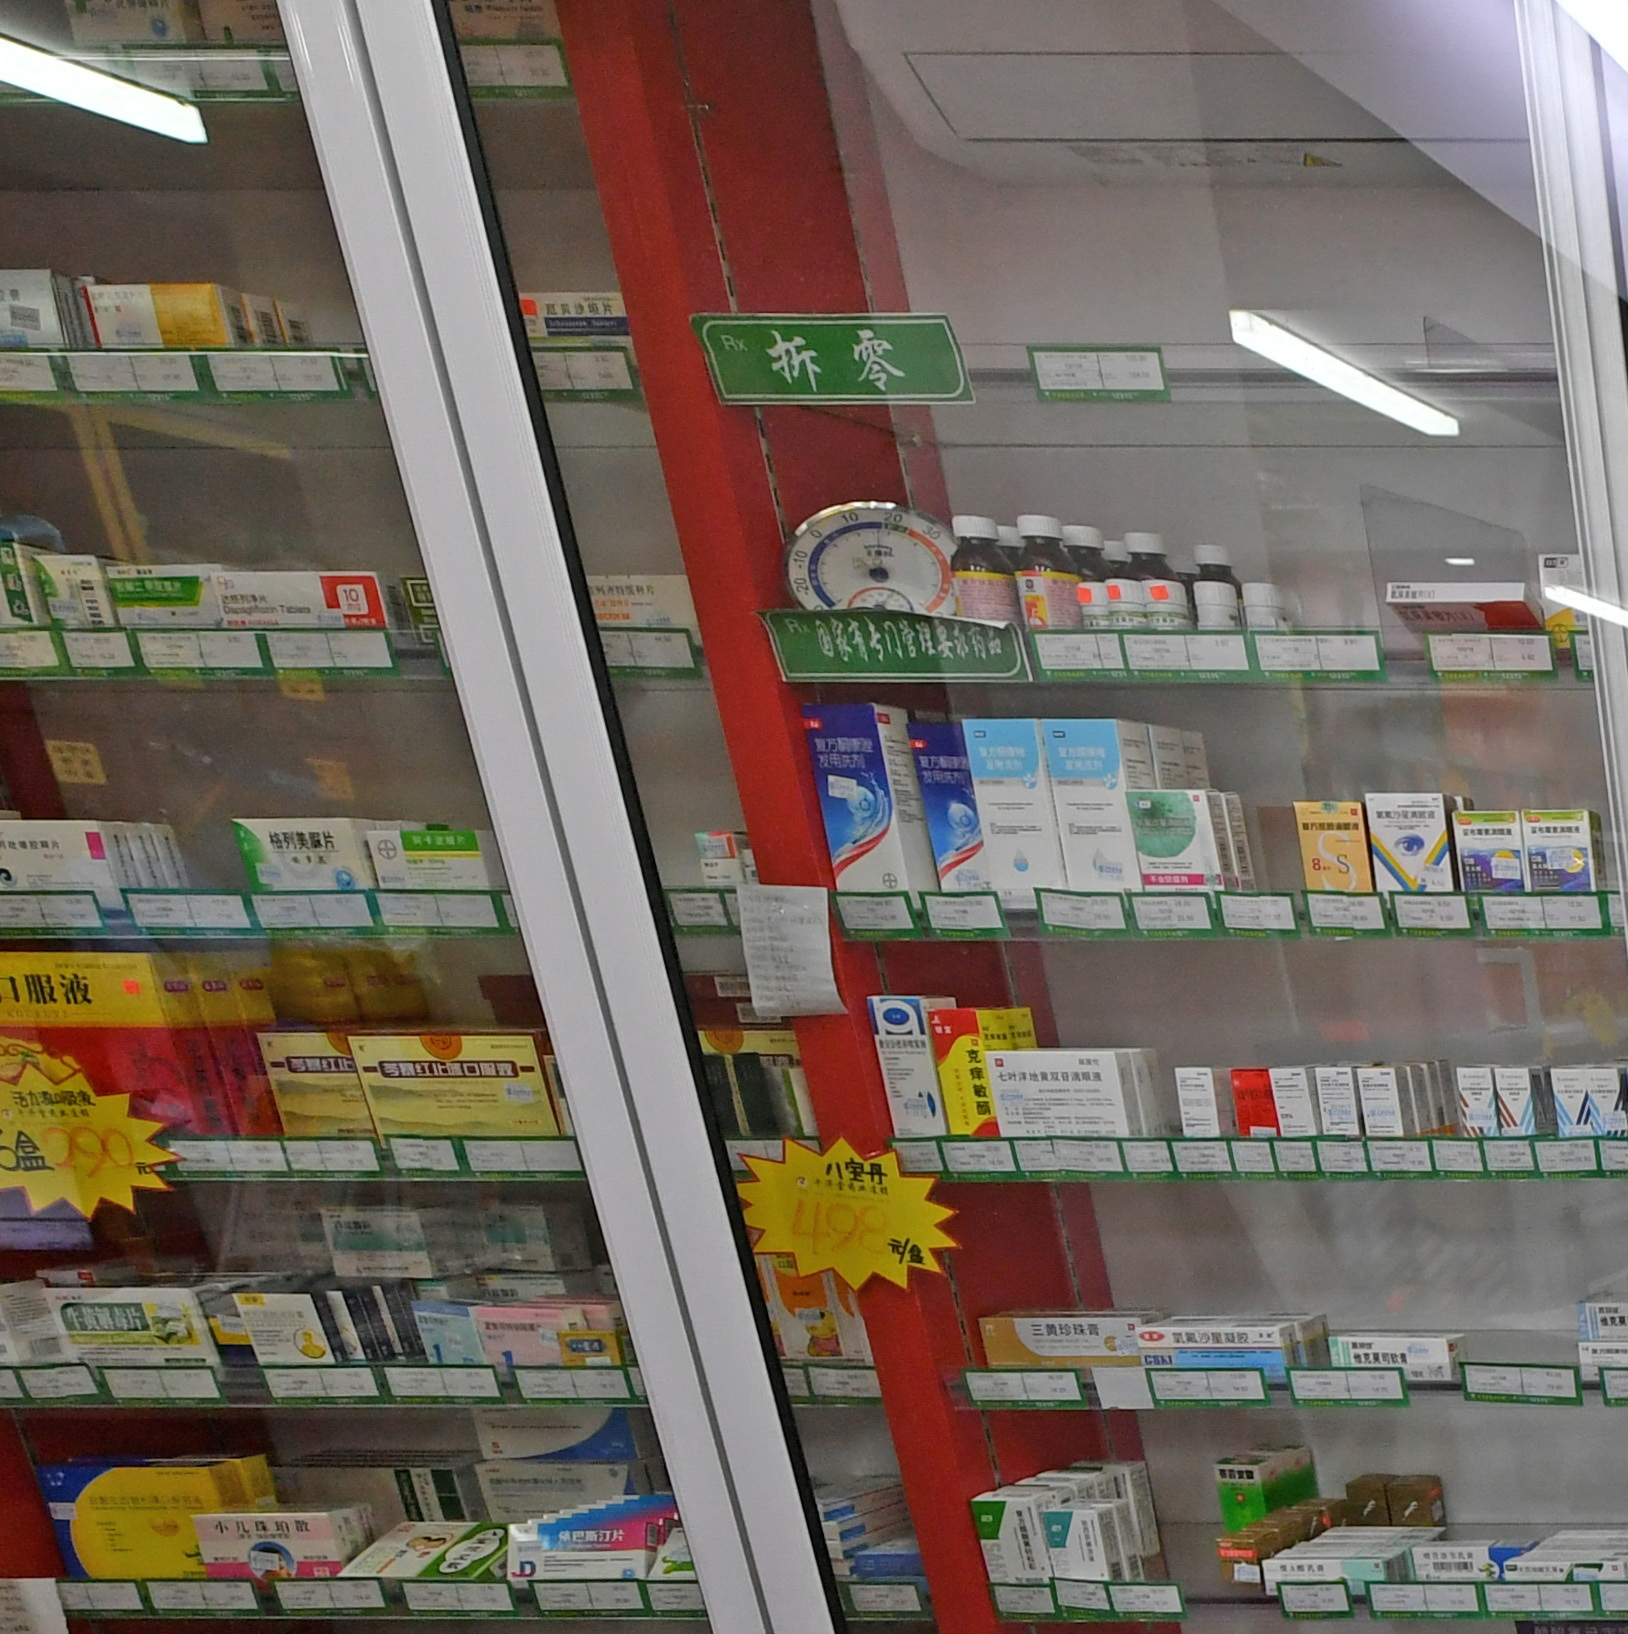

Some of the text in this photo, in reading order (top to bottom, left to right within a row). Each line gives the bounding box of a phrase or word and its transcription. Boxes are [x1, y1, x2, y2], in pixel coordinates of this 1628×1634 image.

[720, 334, 748, 353] Rx
[767, 328, 906, 392] 拆零
[841, 512, 859, 524] 10
[886, 512, 903, 524] 20
[922, 525, 941, 541] 30
[337, 587, 355, 603] 10
[275, 604, 306, 614] Tablets
[268, 830, 335, 851] 格列美脲片
[1311, 855, 1321, 868] 8
[826, 1161, 888, 1185] 八宝丹
[887, 1237, 926, 1266] 元/盒
[1031, 1323, 1101, 1337] 三黄珍珠膏
